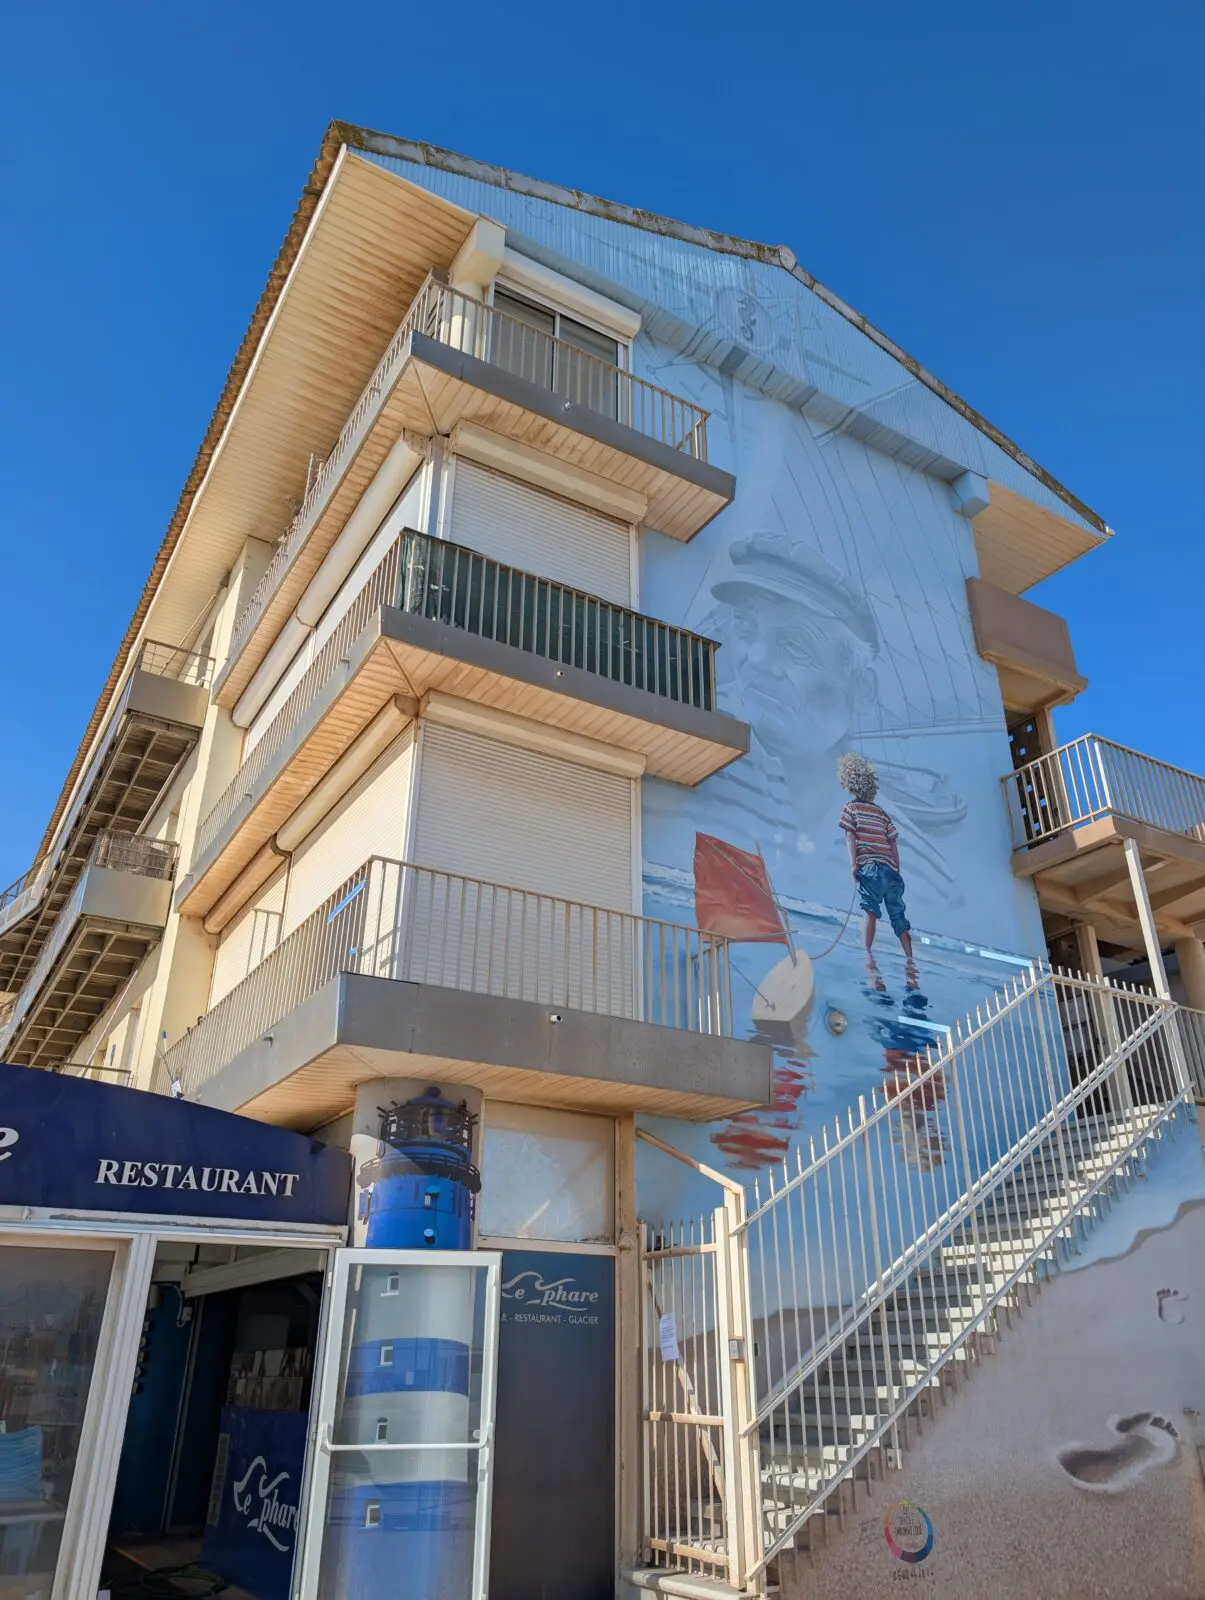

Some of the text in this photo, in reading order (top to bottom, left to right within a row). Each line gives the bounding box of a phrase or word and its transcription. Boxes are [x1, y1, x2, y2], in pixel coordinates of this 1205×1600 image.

[95, 1159, 299, 1196] RESTAURANT
[541, 1285, 599, 1306] phare
[514, 1313, 562, 1324] RESTAURANT
[568, 1315, 599, 1325] GLACIER
